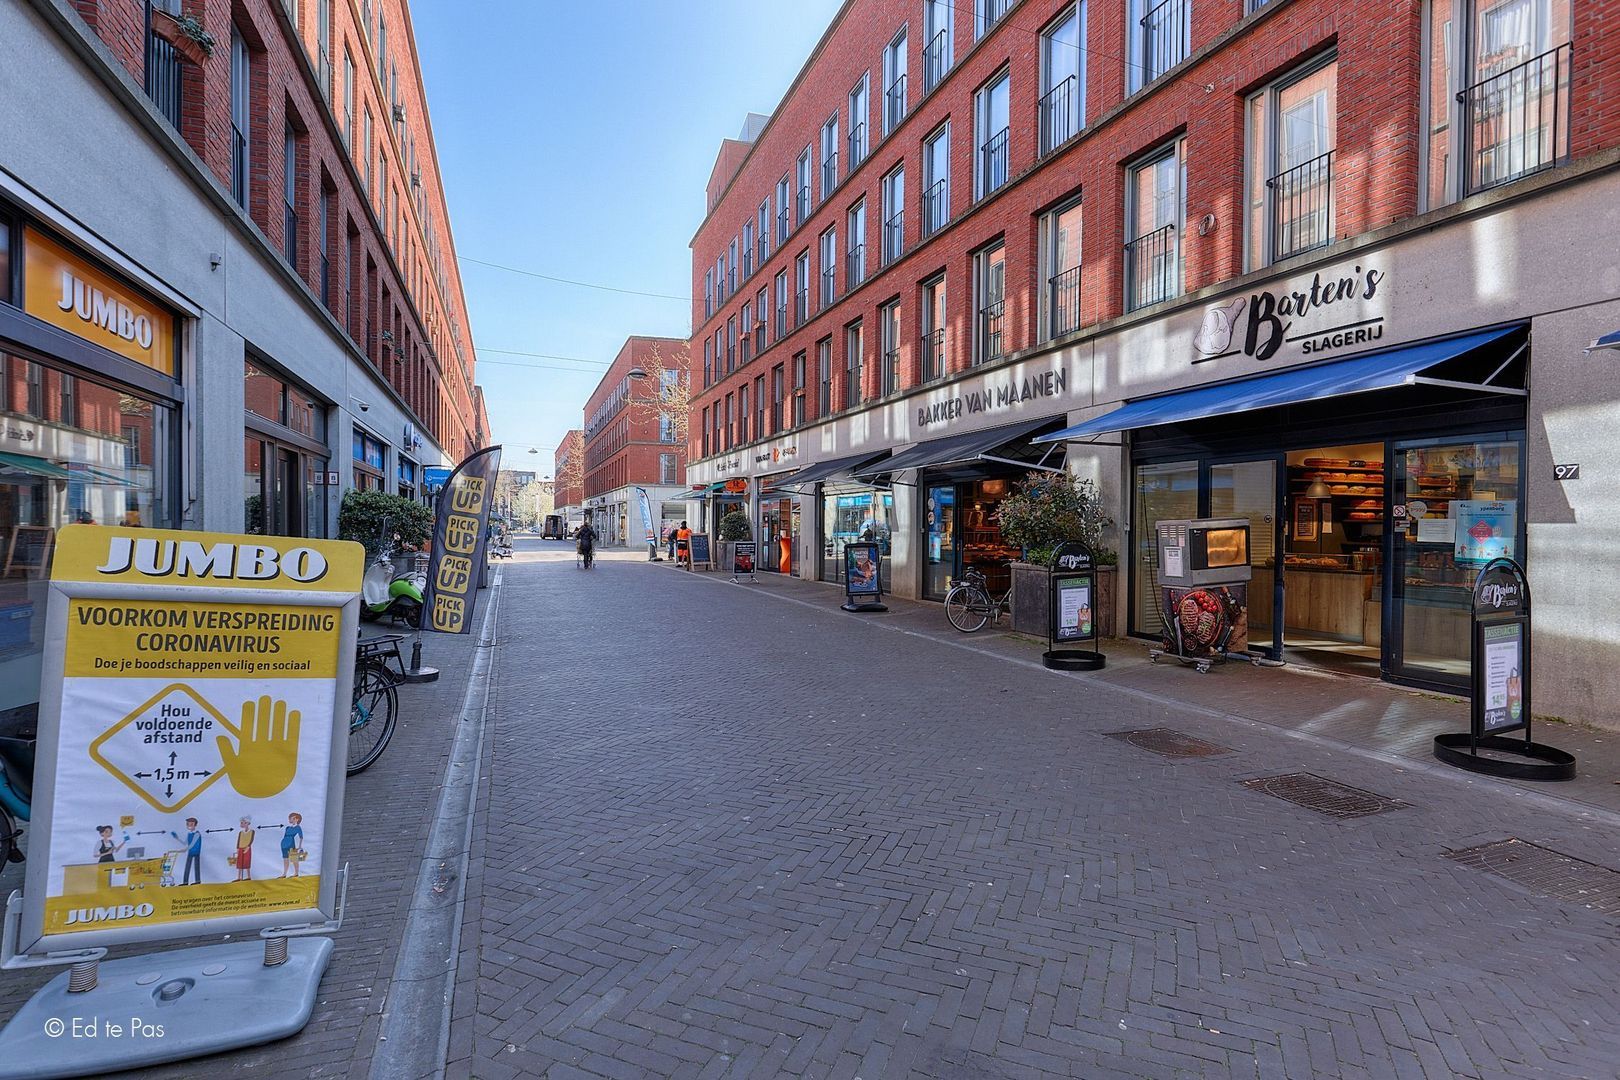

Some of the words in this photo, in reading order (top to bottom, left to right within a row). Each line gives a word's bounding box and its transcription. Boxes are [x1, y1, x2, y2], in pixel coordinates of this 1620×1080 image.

[57, 271, 153, 350] JUMBO
[1244, 265, 1385, 361] Barten's
[1302, 324, 1384, 355] SLAGERIJ
[917, 397, 963, 428] BAKKER
[965, 389, 993, 414] VAN
[996, 367, 1066, 408] MAANEN
[1555, 465, 1578, 479] 97
[456, 490, 482, 509] UP
[450, 517, 475, 531] PICK
[448, 529, 475, 549] UP
[96, 537, 329, 583] JUMBO
[444, 557, 469, 571] PICK
[440, 570, 467, 589] UP
[437, 597, 461, 611] PICK
[78, 606, 188, 628] VOORKOM
[193, 611, 335, 631] VERSPREIDING
[435, 609, 461, 628] UP
[136, 632, 280, 653] CORONAVIRUS
[95, 657, 118, 668] Doe
[120, 658, 132, 672] je
[135, 658, 221, 672] boodschappen
[224, 660, 255, 673] veilig
[257, 662, 270, 671] en
[272, 660, 311, 670] sociaal
[161, 704, 190, 717] Hou
[136, 717, 212, 731] voldoende
[143, 730, 202, 744] afstand
[154, 767, 174, 782] 1,5
[177, 770, 190, 780] m
[64, 903, 155, 925] JUMBO
